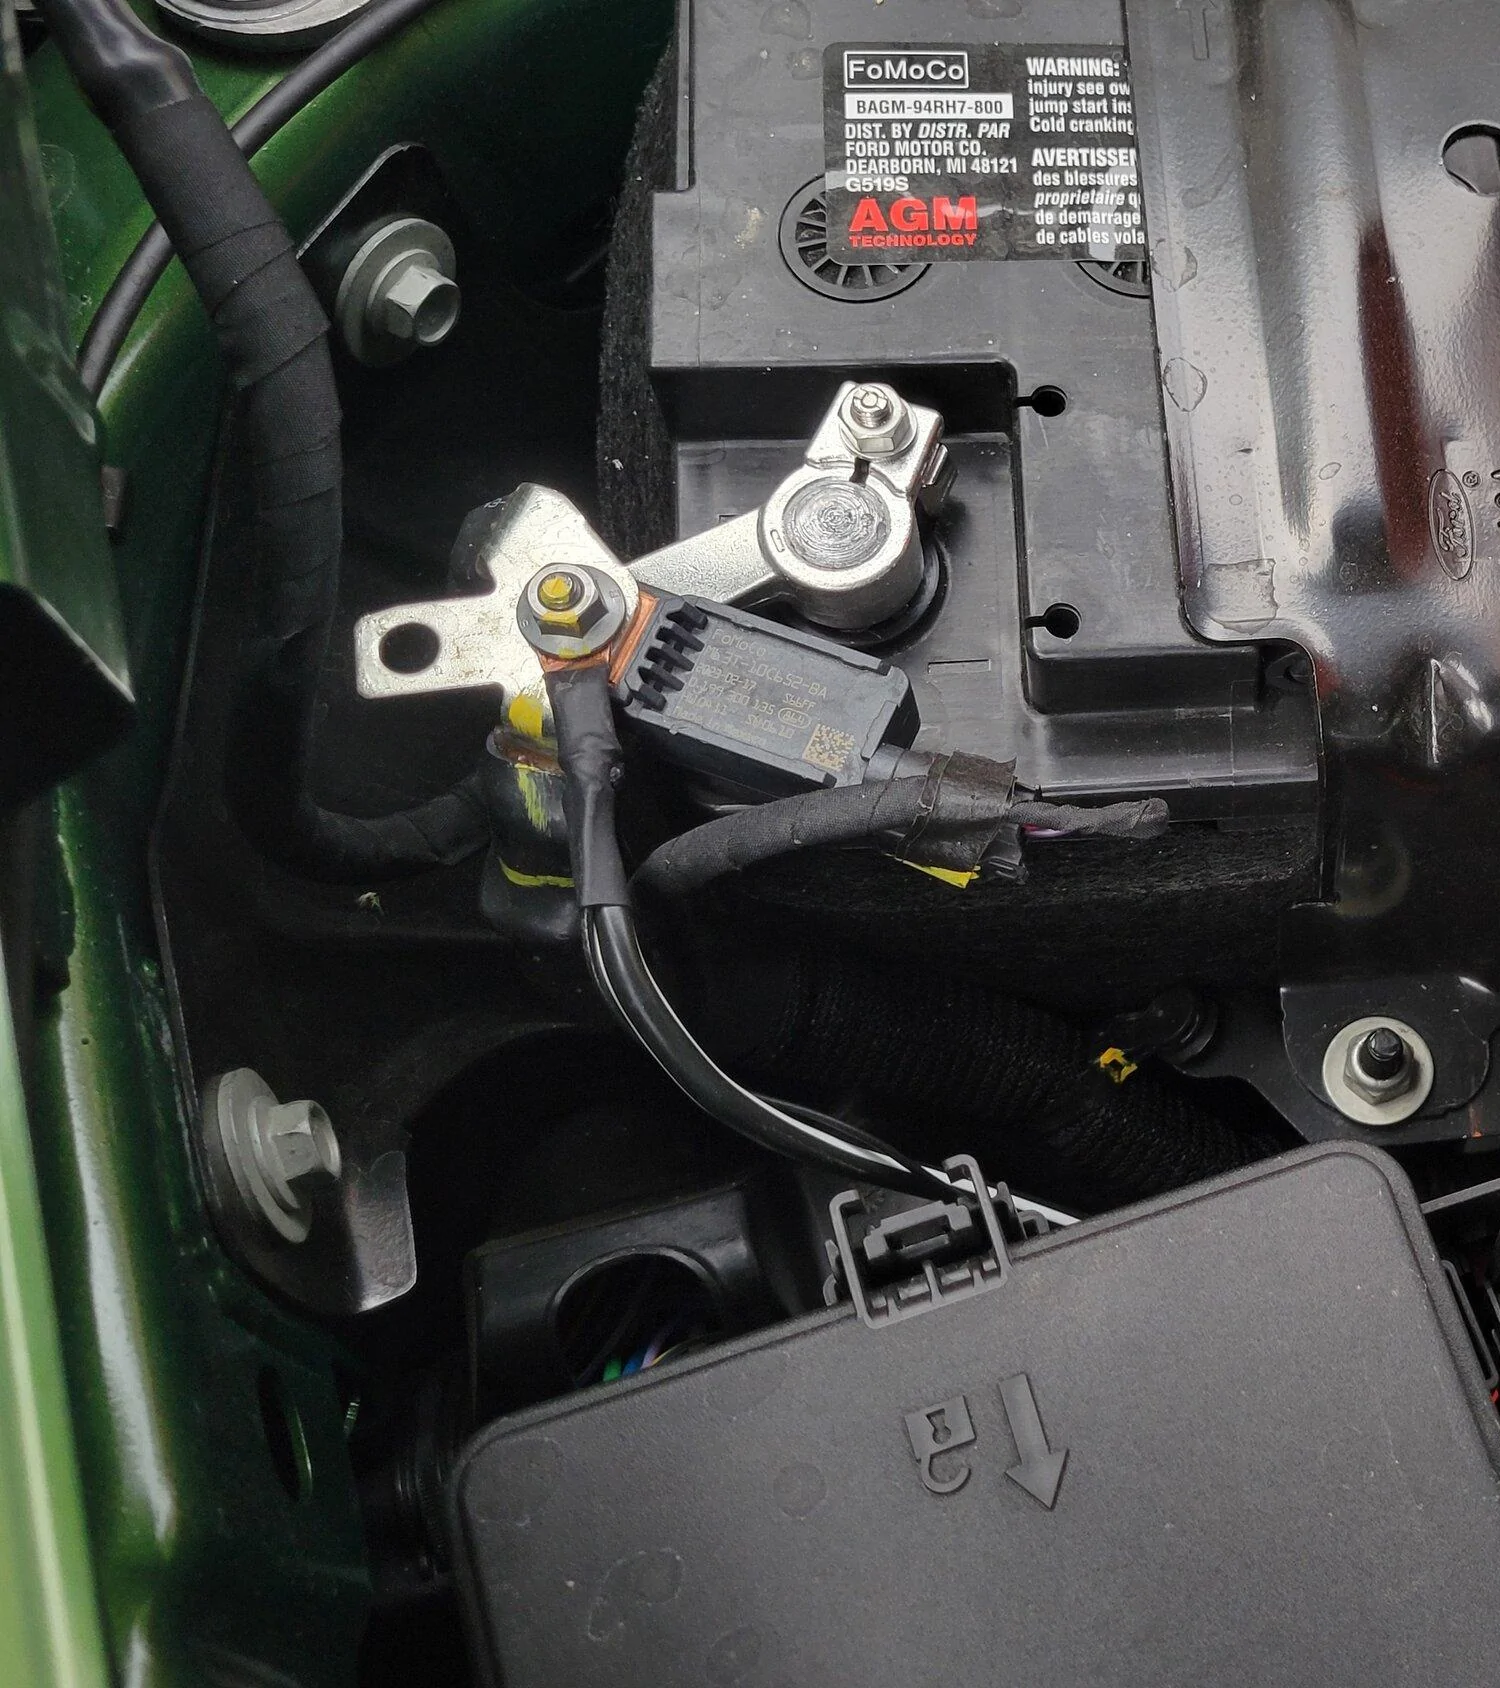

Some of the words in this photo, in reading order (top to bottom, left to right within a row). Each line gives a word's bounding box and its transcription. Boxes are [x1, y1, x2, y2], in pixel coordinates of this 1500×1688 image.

[849, 59, 965, 80] FoMoCo
[1026, 57, 1121, 77] WARNING:
[1028, 79, 1073, 97] injury
[1076, 81, 1105, 96] see
[1109, 82, 1130, 95] ow
[856, 99, 1004, 115] BAGM-94RH7-800
[1029, 98, 1068, 116] jump
[1072, 98, 1108, 114] start
[845, 123, 887, 139] DIST.
[891, 123, 912, 139] BY
[918, 122, 972, 139] DISTR.
[977, 122, 1011, 138] PAR
[1030, 117, 1065, 133] Cold
[1069, 116, 1134, 136] cranking
[845, 140, 890, 157] FORD
[895, 140, 954, 157] MOTOR
[958, 140, 987, 156] CO.
[846, 158, 941, 175] DEARBORN,
[946, 158, 967, 174] MI
[970, 157, 1018, 174] 48121
[846, 176, 909, 192] G519S
[1033, 170, 1060, 186] des
[1064, 169, 1137, 187] blessures
[1034, 189, 1125, 209] proprietaire
[849, 195, 978, 232] AGM
[1035, 209, 1055, 226] de
[1059, 209, 1141, 229] demarrage
[850, 234, 977, 247] TECHNOLOGY
[1036, 228, 1055, 245] de
[1059, 227, 1109, 245] cables
[1113, 229, 1145, 245] vola
[711, 628, 767, 658] FoMoCo
